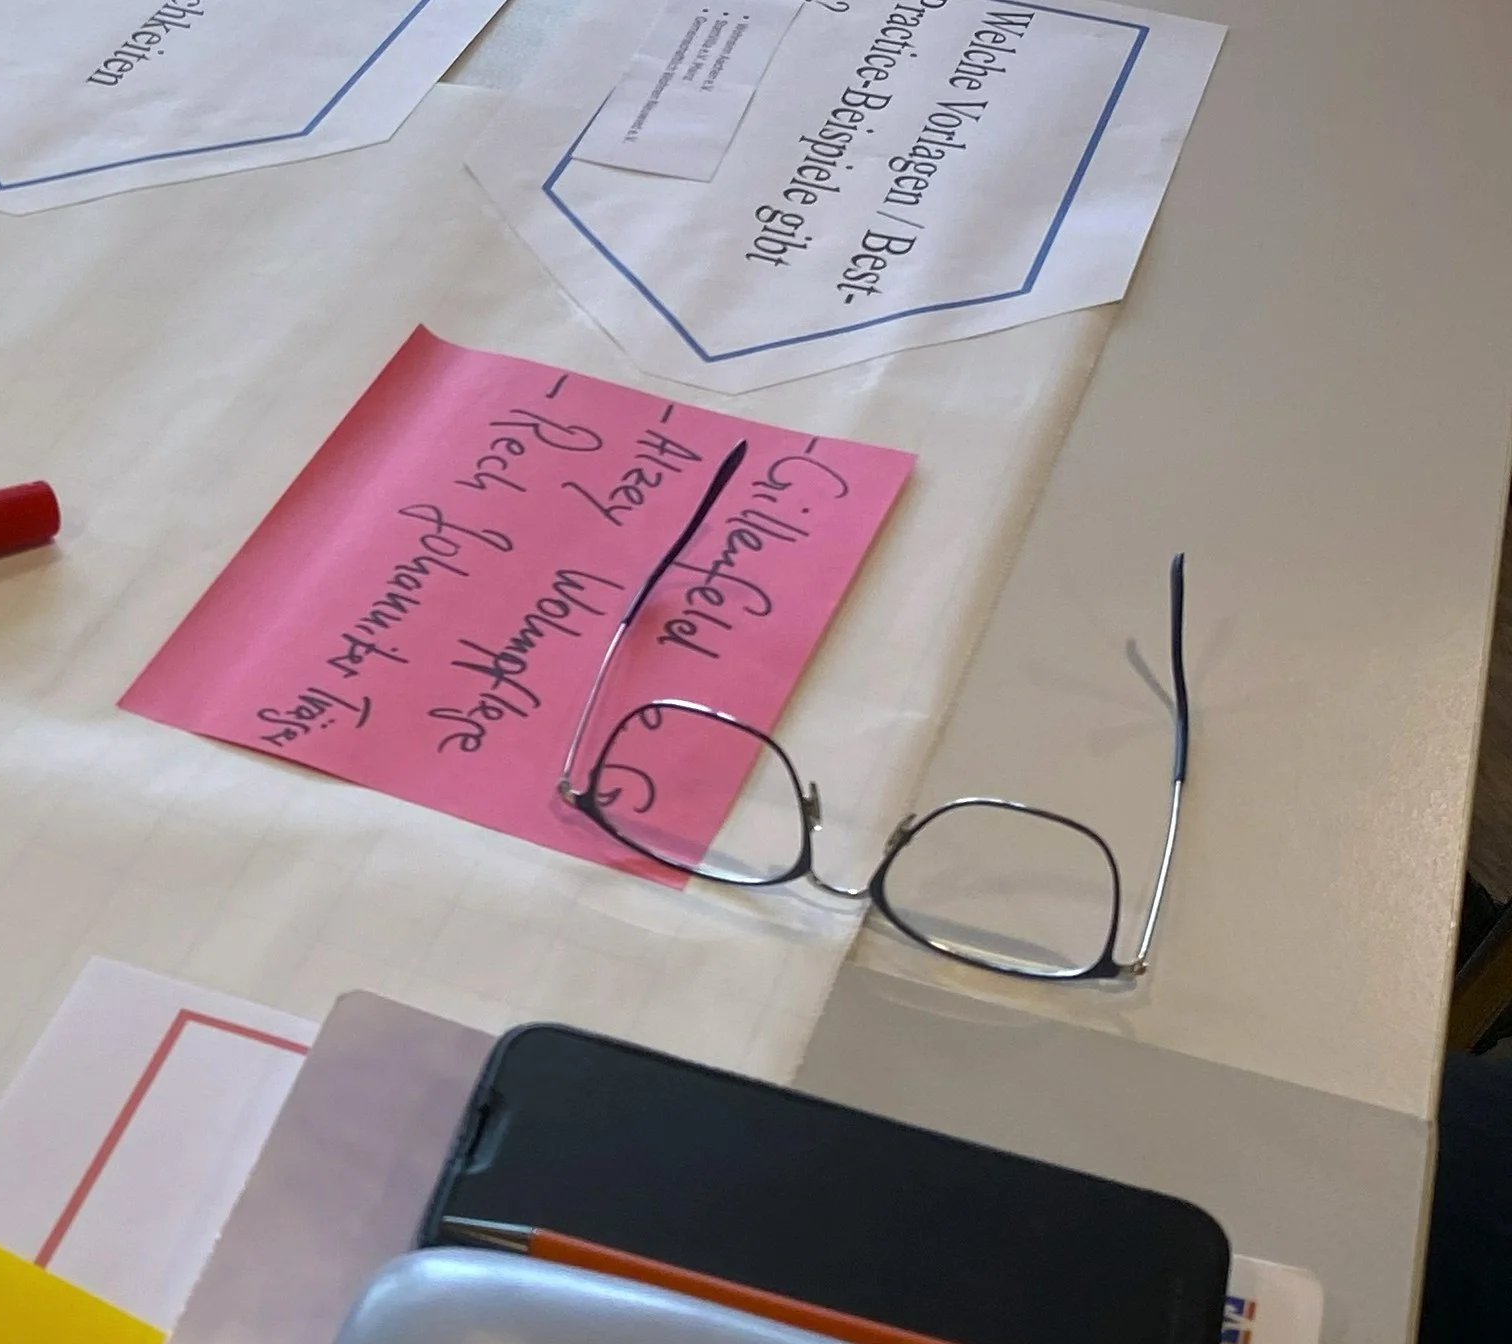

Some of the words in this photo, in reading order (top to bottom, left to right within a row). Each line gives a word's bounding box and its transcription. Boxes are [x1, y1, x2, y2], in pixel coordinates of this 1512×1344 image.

[949, 12, 1035, 90] Welche
[884, 102, 988, 205] Vorlagen
[746, 206, 812, 266] gibt
[876, 211, 925, 229] /
[837, 230, 916, 304] Best-
[455, 409, 603, 492] Rech
[561, 429, 702, 526] Alzey
[327, 504, 513, 678] Johanniter
[657, 456, 848, 658] Gillenfeld
